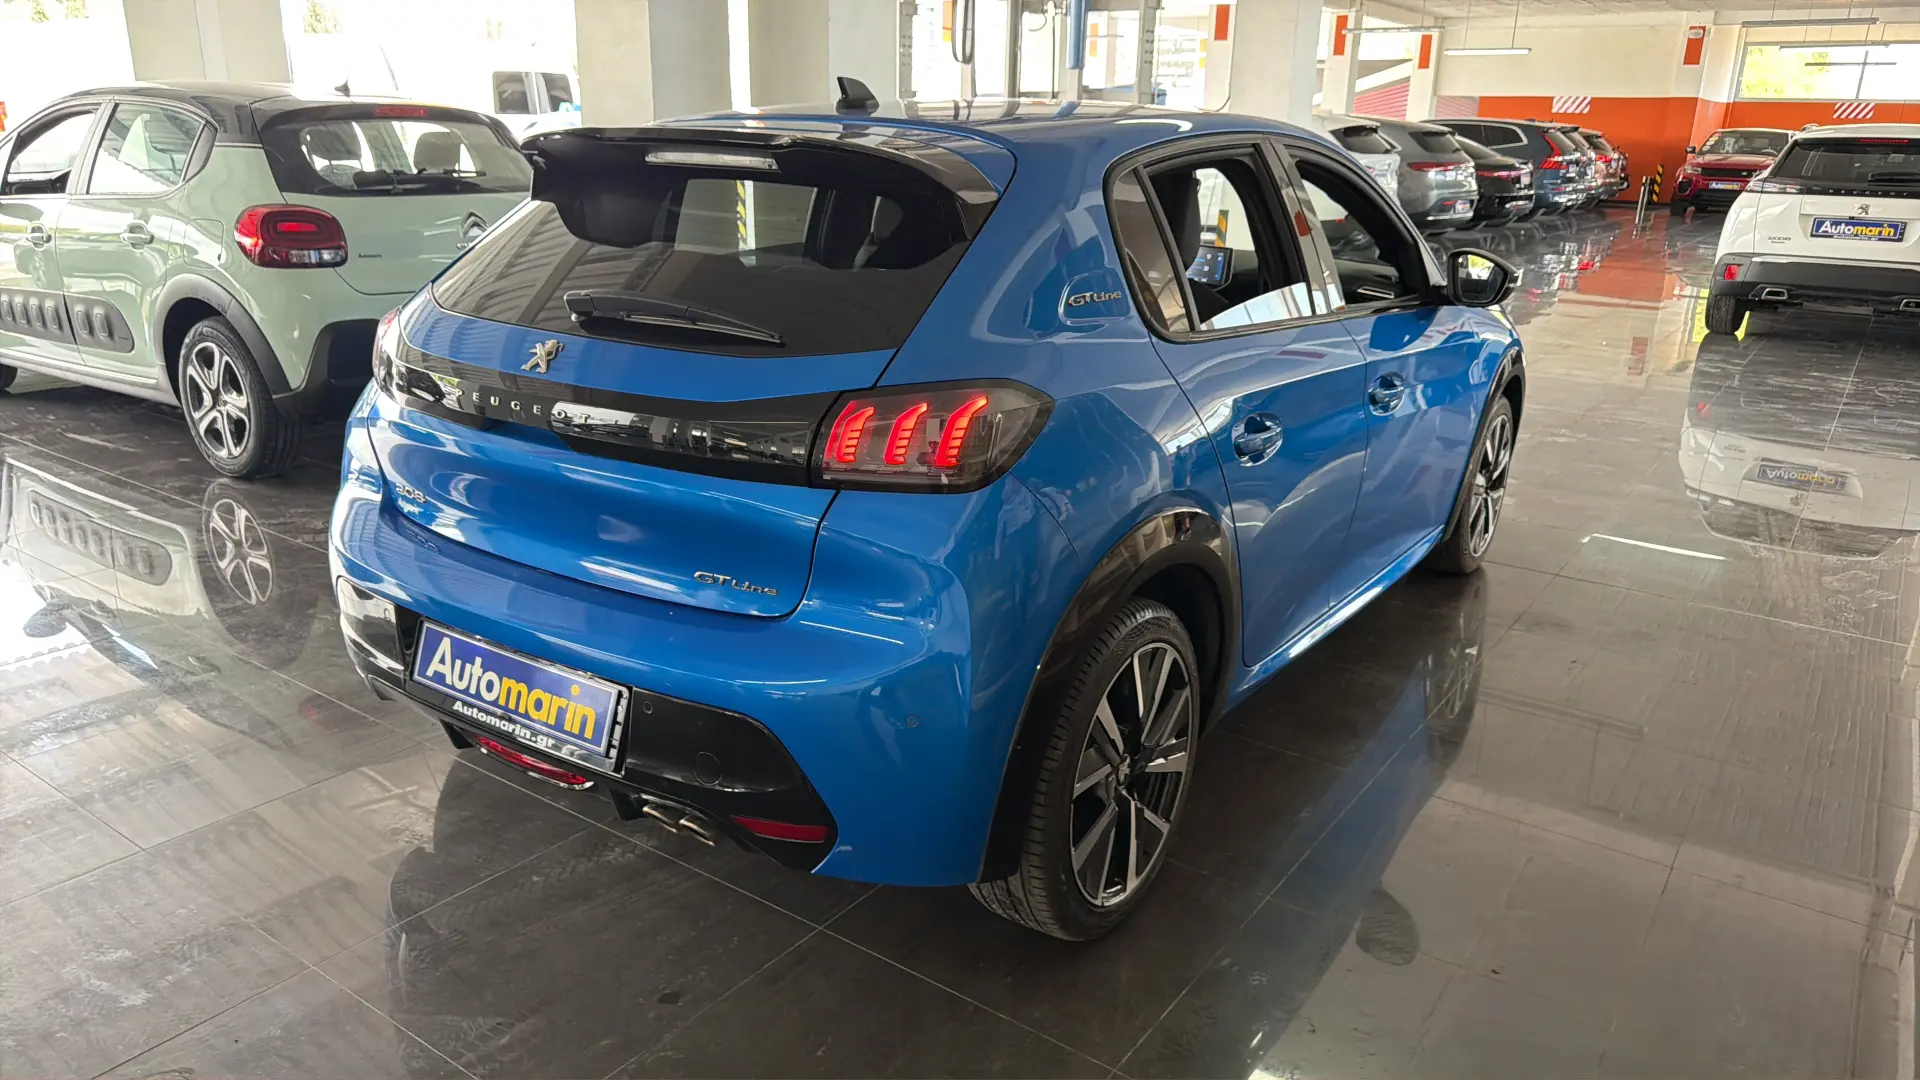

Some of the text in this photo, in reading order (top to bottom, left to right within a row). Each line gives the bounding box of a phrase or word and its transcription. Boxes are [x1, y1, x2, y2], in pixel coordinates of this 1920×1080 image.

[1828, 189, 1908, 197] PEUGEOT
[1818, 220, 1895, 237] Automarin
[1068, 290, 1122, 307] GT Line
[455, 388, 590, 423] PEUGEOT
[395, 483, 427, 504] 208
[693, 570, 779, 596] GT Line
[426, 637, 596, 739] Automarin
[453, 700, 555, 748] Automarin.gr
